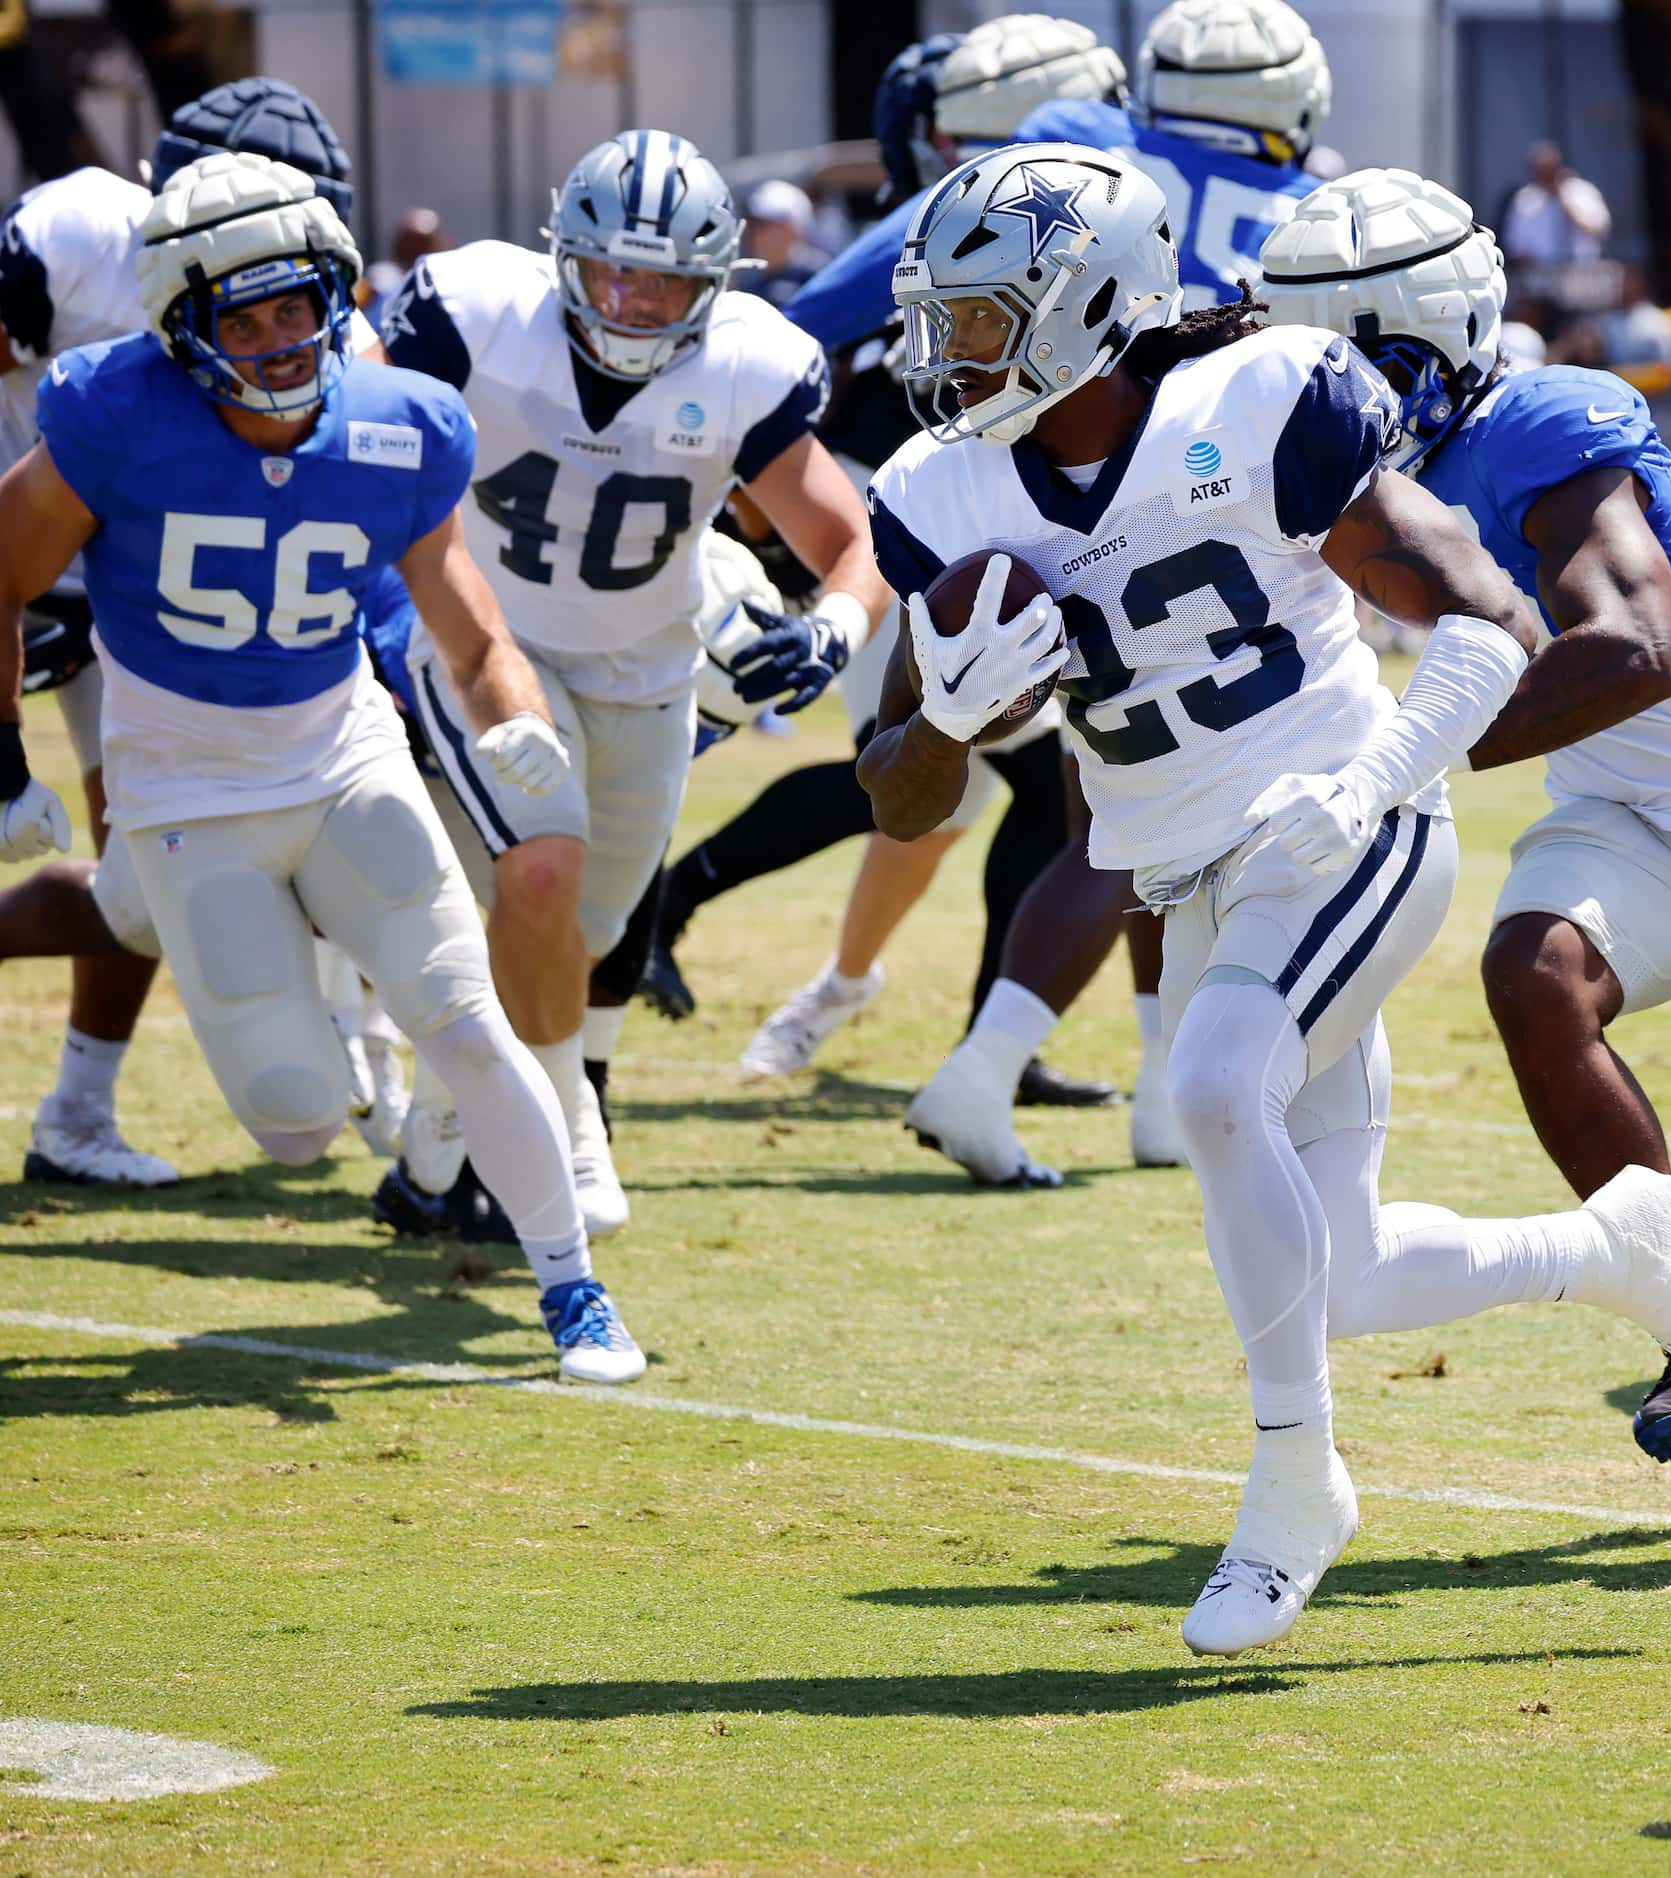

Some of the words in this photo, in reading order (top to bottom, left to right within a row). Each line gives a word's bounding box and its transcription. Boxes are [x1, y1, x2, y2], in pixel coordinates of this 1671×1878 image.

[668, 433, 705, 448] AT&T
[470, 449, 693, 592] 40
[1189, 477, 1233, 504] AT&T
[155, 511, 372, 651] 56
[1061, 535, 1129, 576] COWBOYS
[1054, 538, 1307, 767] 23
